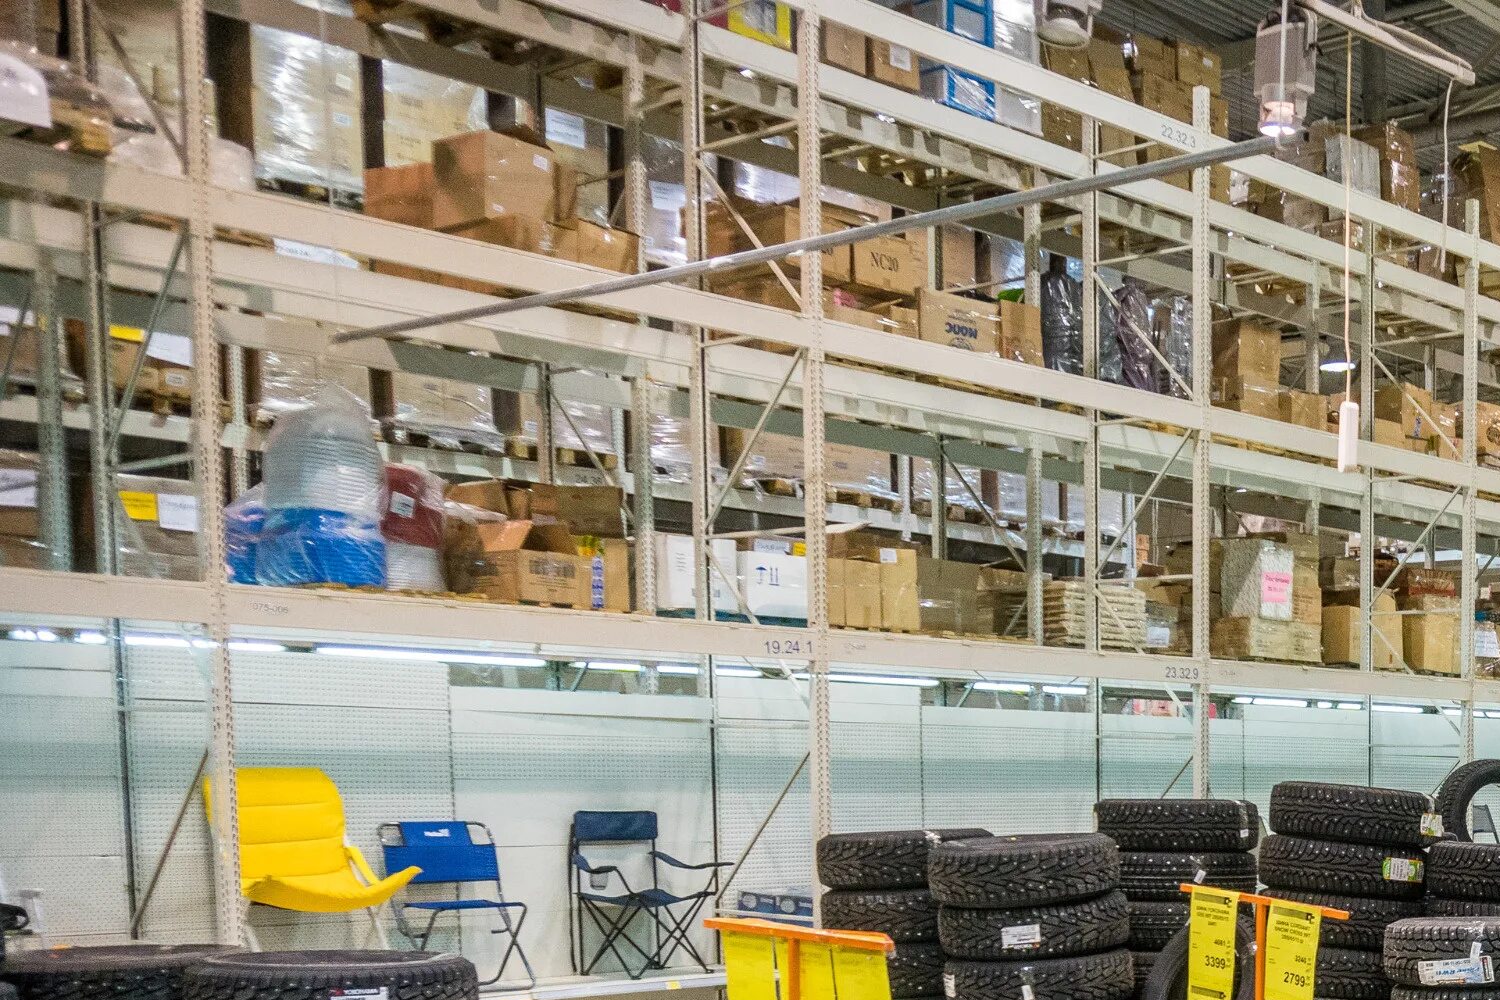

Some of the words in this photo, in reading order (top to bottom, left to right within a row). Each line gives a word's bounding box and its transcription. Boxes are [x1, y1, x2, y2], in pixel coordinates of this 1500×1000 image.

[765, 640, 813, 654] 19.24.1
[1165, 666, 1199, 680] 23.32.9
[1204, 955, 1226, 970] 3399
[1283, 971, 1306, 987] 2799
